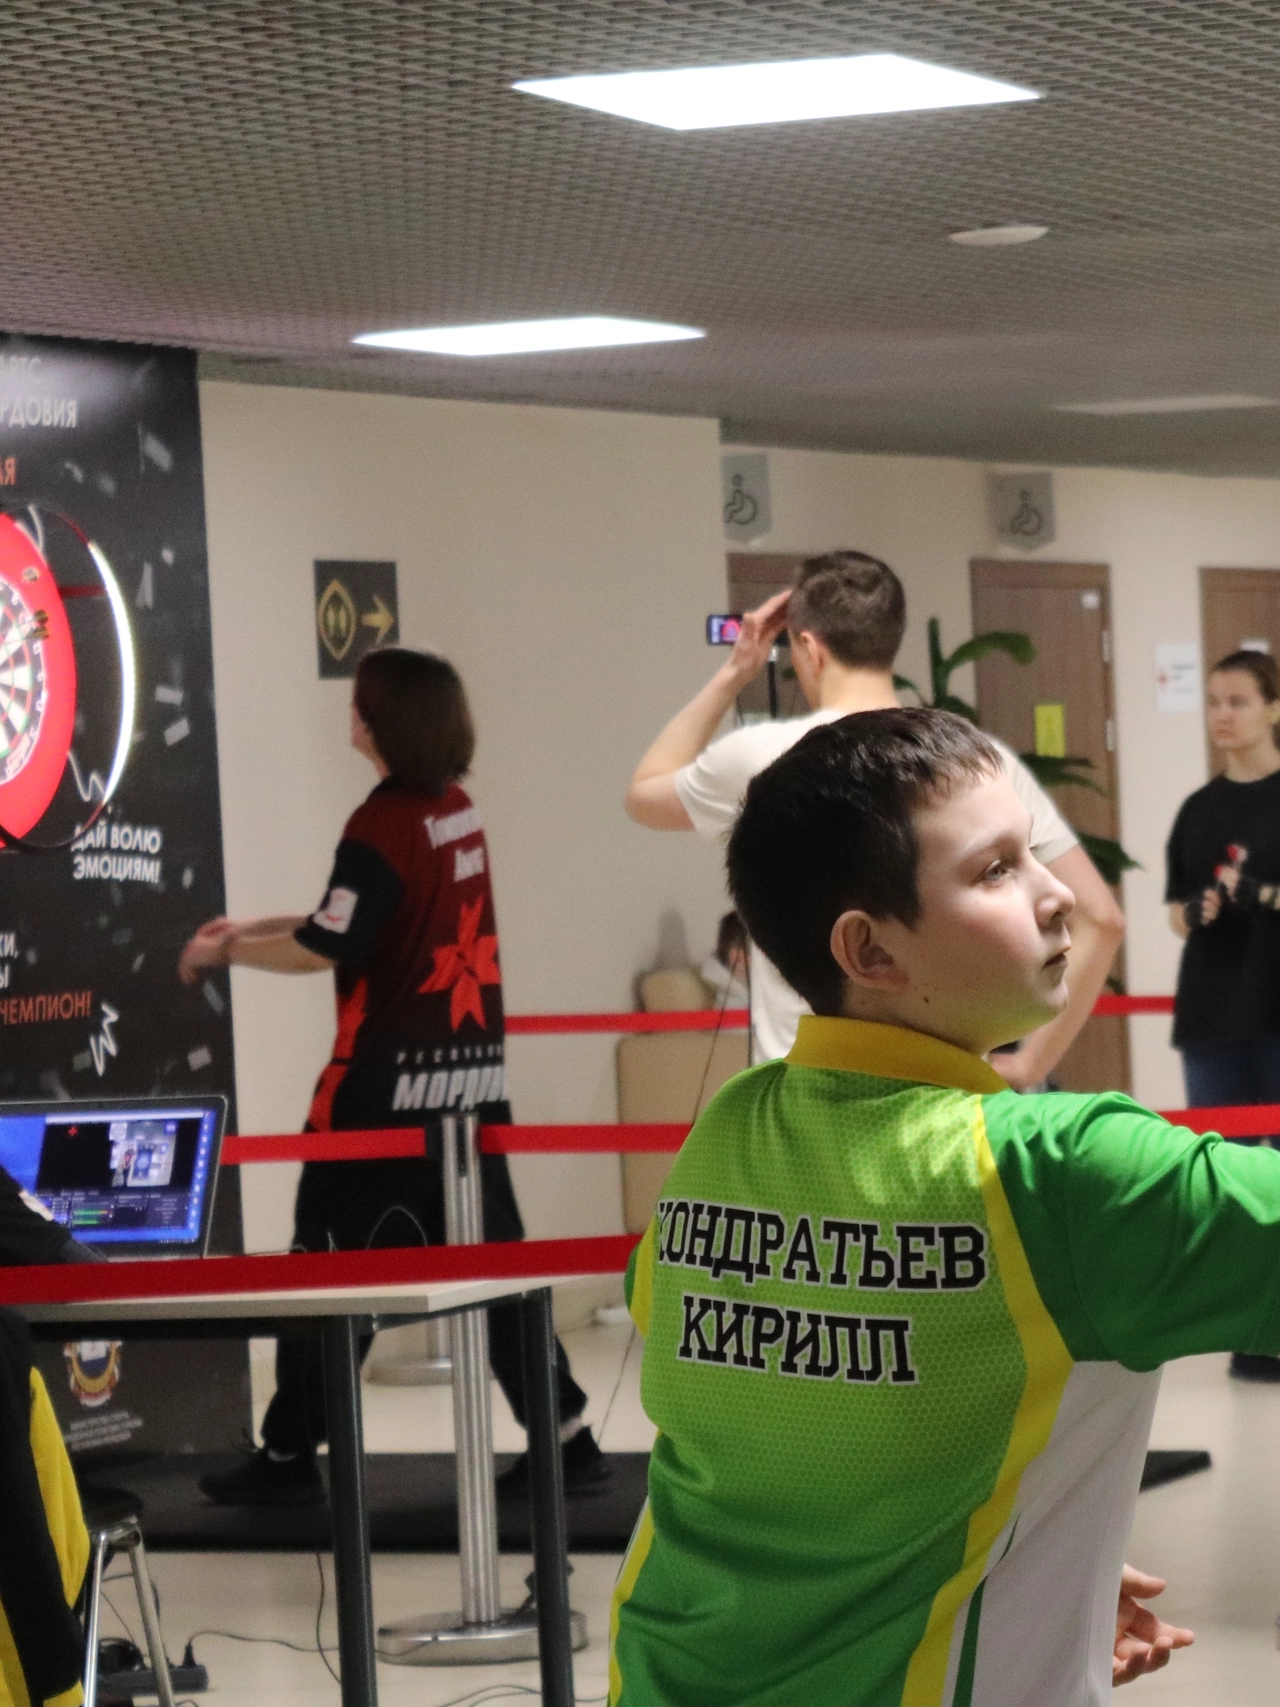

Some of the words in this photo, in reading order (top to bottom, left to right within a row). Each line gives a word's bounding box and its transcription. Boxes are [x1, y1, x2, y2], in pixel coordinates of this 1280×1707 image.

[0, 456, 16, 485] Я
[71, 818, 107, 852] ДАЙ
[110, 824, 161, 854] ВОЛЮ
[73, 854, 161, 884] ЭМОЦИЯМ!
[0, 990, 92, 1025] ЧЕМПИОН!
[677, 1294, 917, 1383] КИРИЛЛ
